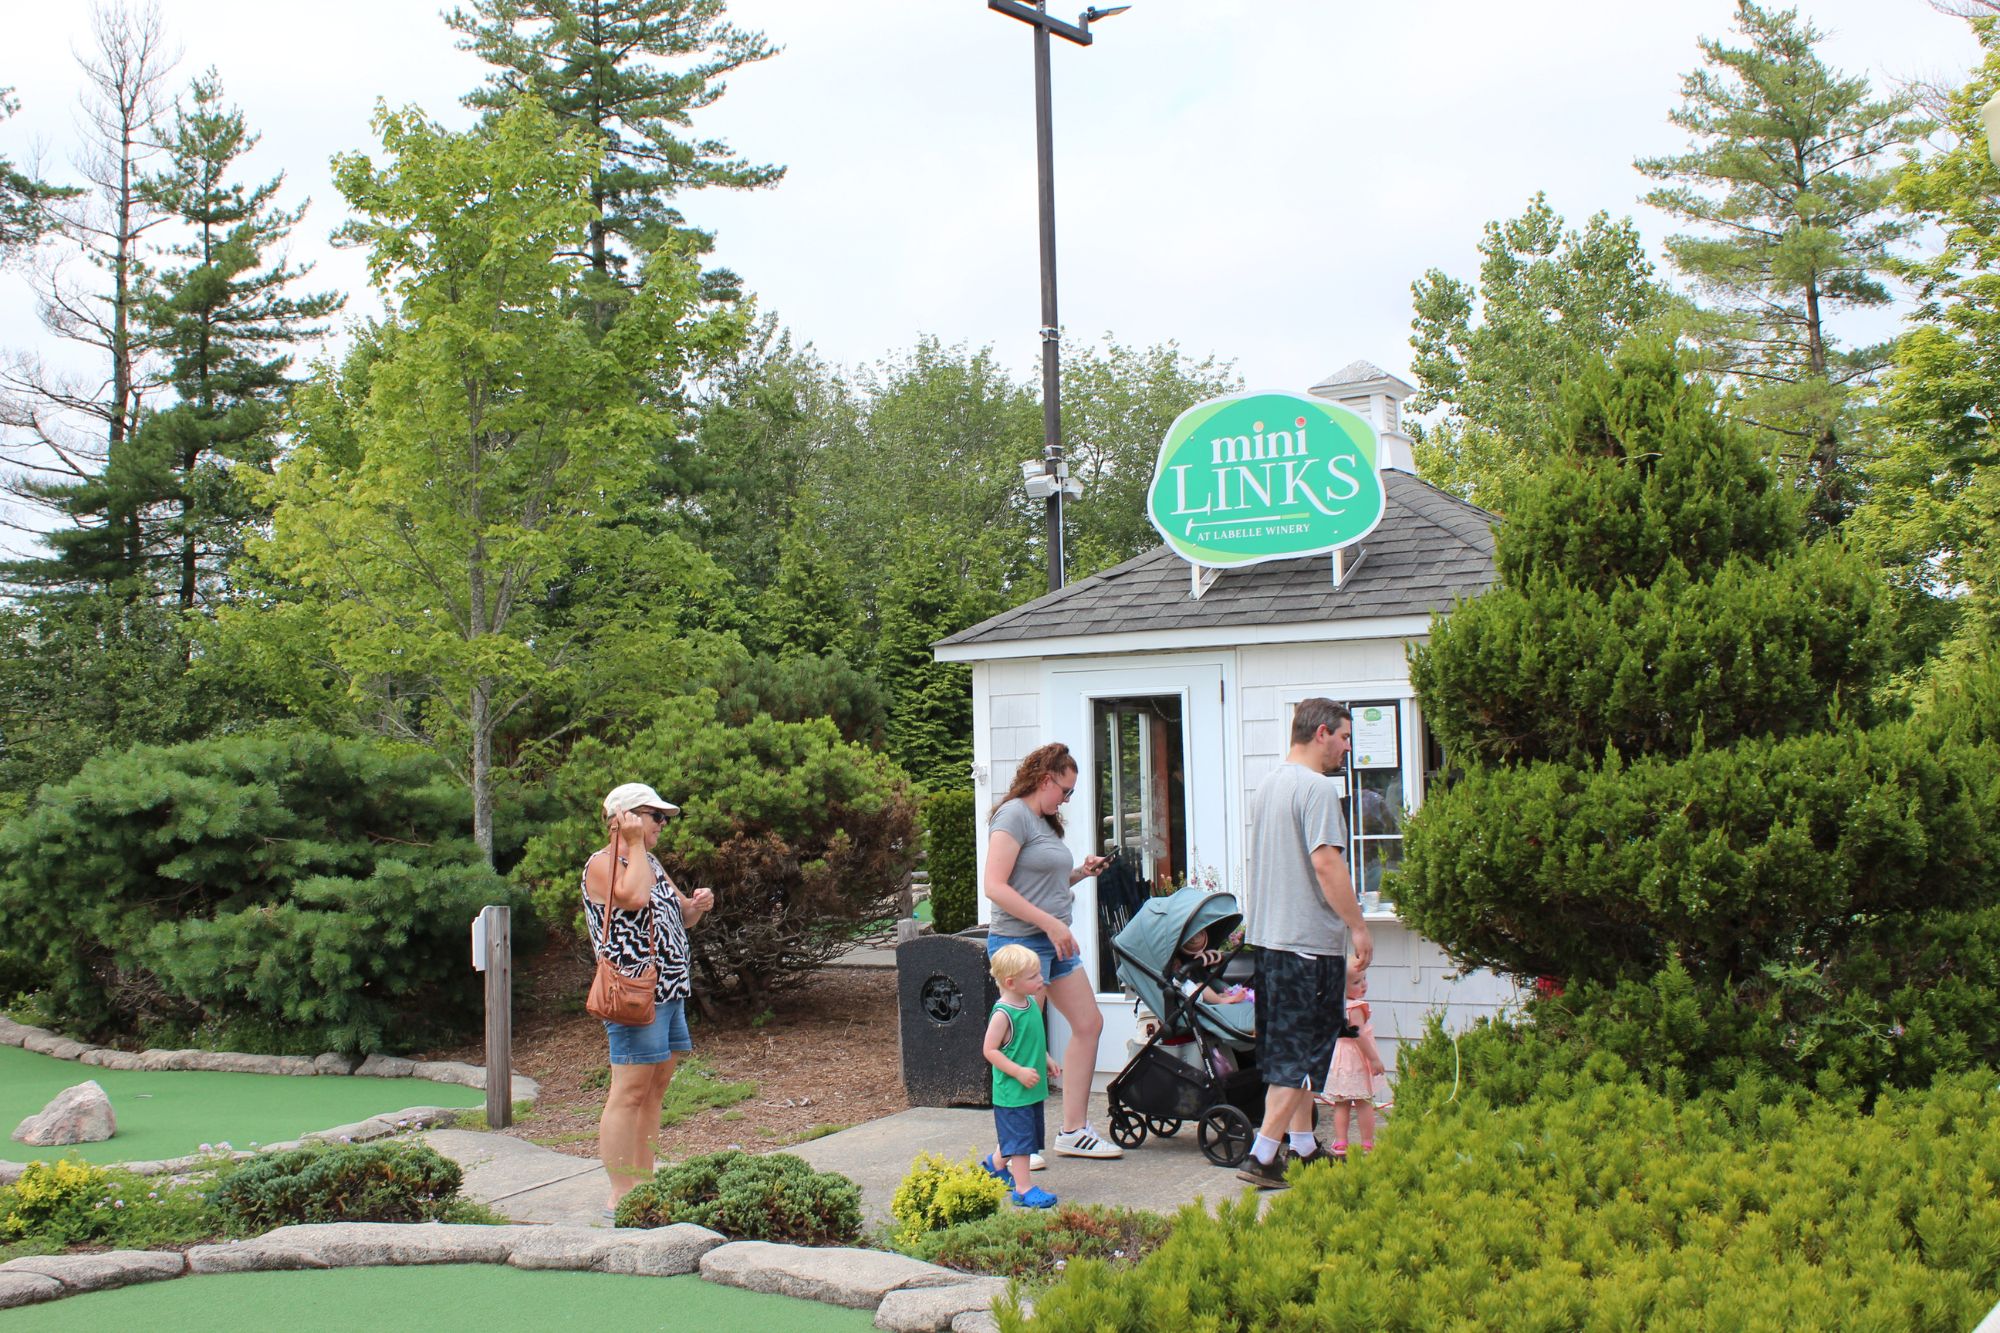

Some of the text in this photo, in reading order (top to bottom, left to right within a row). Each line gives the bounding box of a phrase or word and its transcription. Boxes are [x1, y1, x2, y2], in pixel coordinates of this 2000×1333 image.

[1211, 417, 1309, 464] mini
[1169, 455, 1360, 516] LINKS
[1197, 523, 1310, 542] AT LABELLE WINERY
